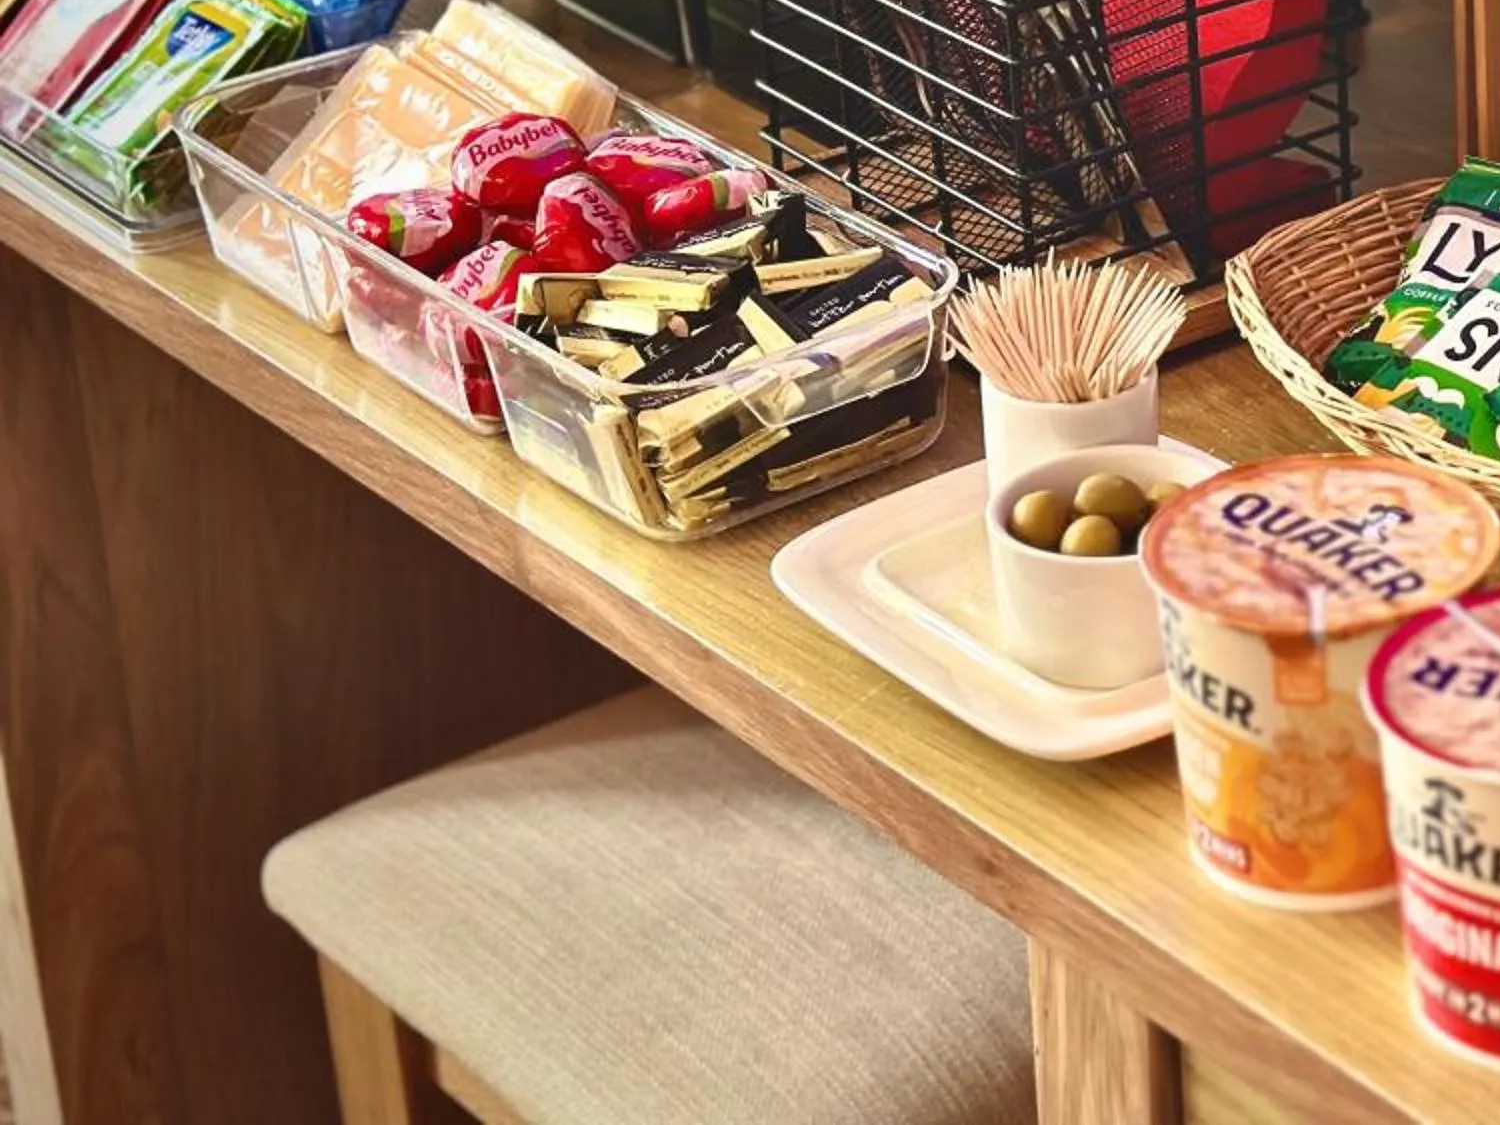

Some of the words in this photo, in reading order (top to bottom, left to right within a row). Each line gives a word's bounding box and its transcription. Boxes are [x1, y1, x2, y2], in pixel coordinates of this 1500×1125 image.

[467, 123, 562, 168] Babybel
[575, 186, 638, 255] abybel
[451, 242, 501, 302] bybel
[1221, 491, 1426, 602] QUAKER
